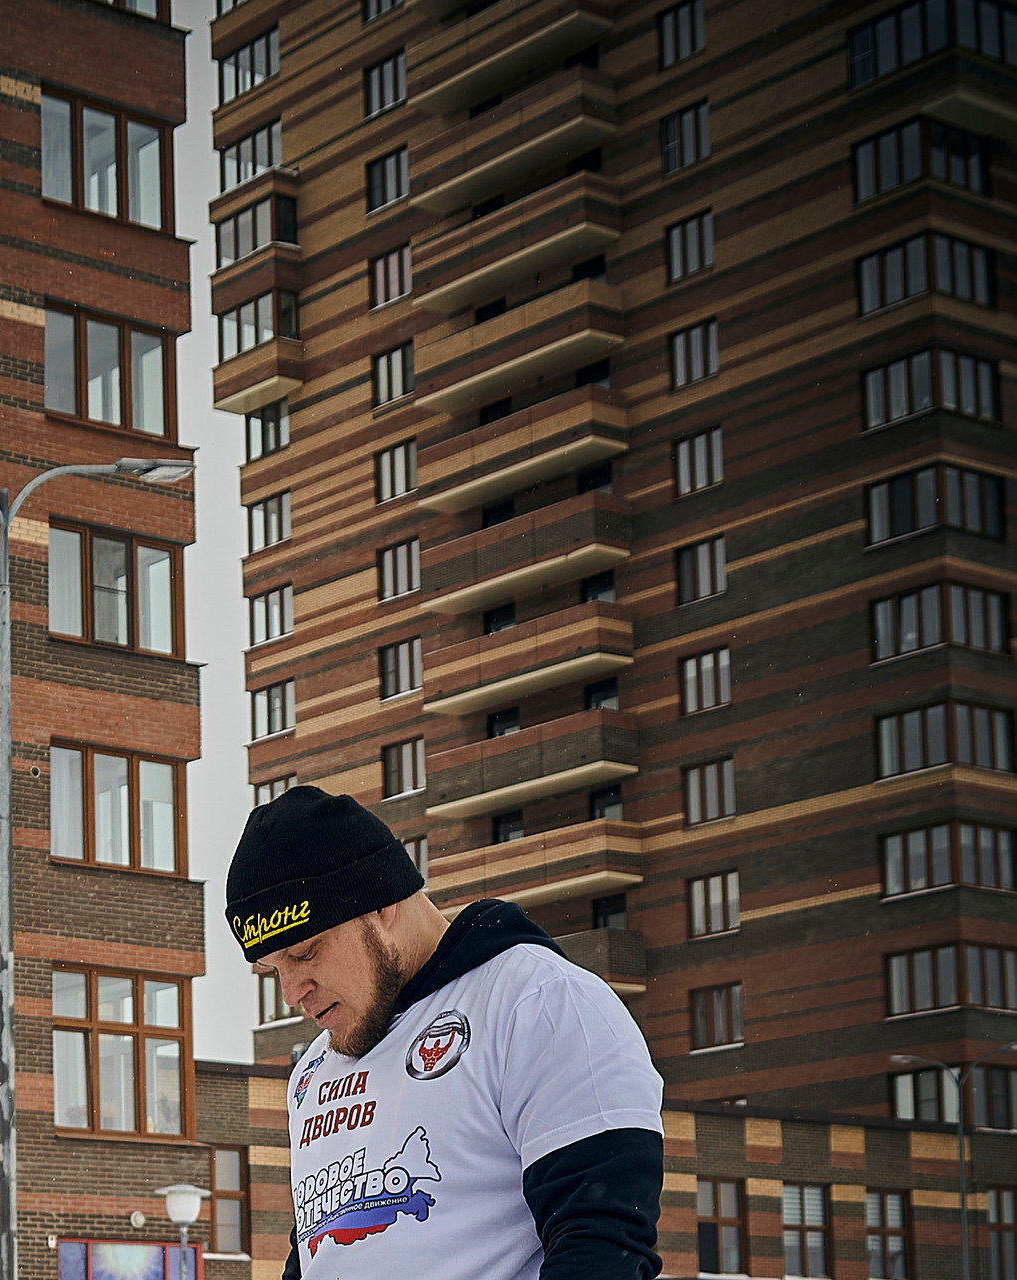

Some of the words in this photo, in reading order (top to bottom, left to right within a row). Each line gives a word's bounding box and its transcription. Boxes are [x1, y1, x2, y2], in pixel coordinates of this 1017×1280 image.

[232, 900, 311, 944] Стронг
[318, 1070, 370, 1106] СИЛА
[299, 1100, 377, 1150] ДВОРОВ
[294, 1147, 366, 1207] ОРОВОЕ
